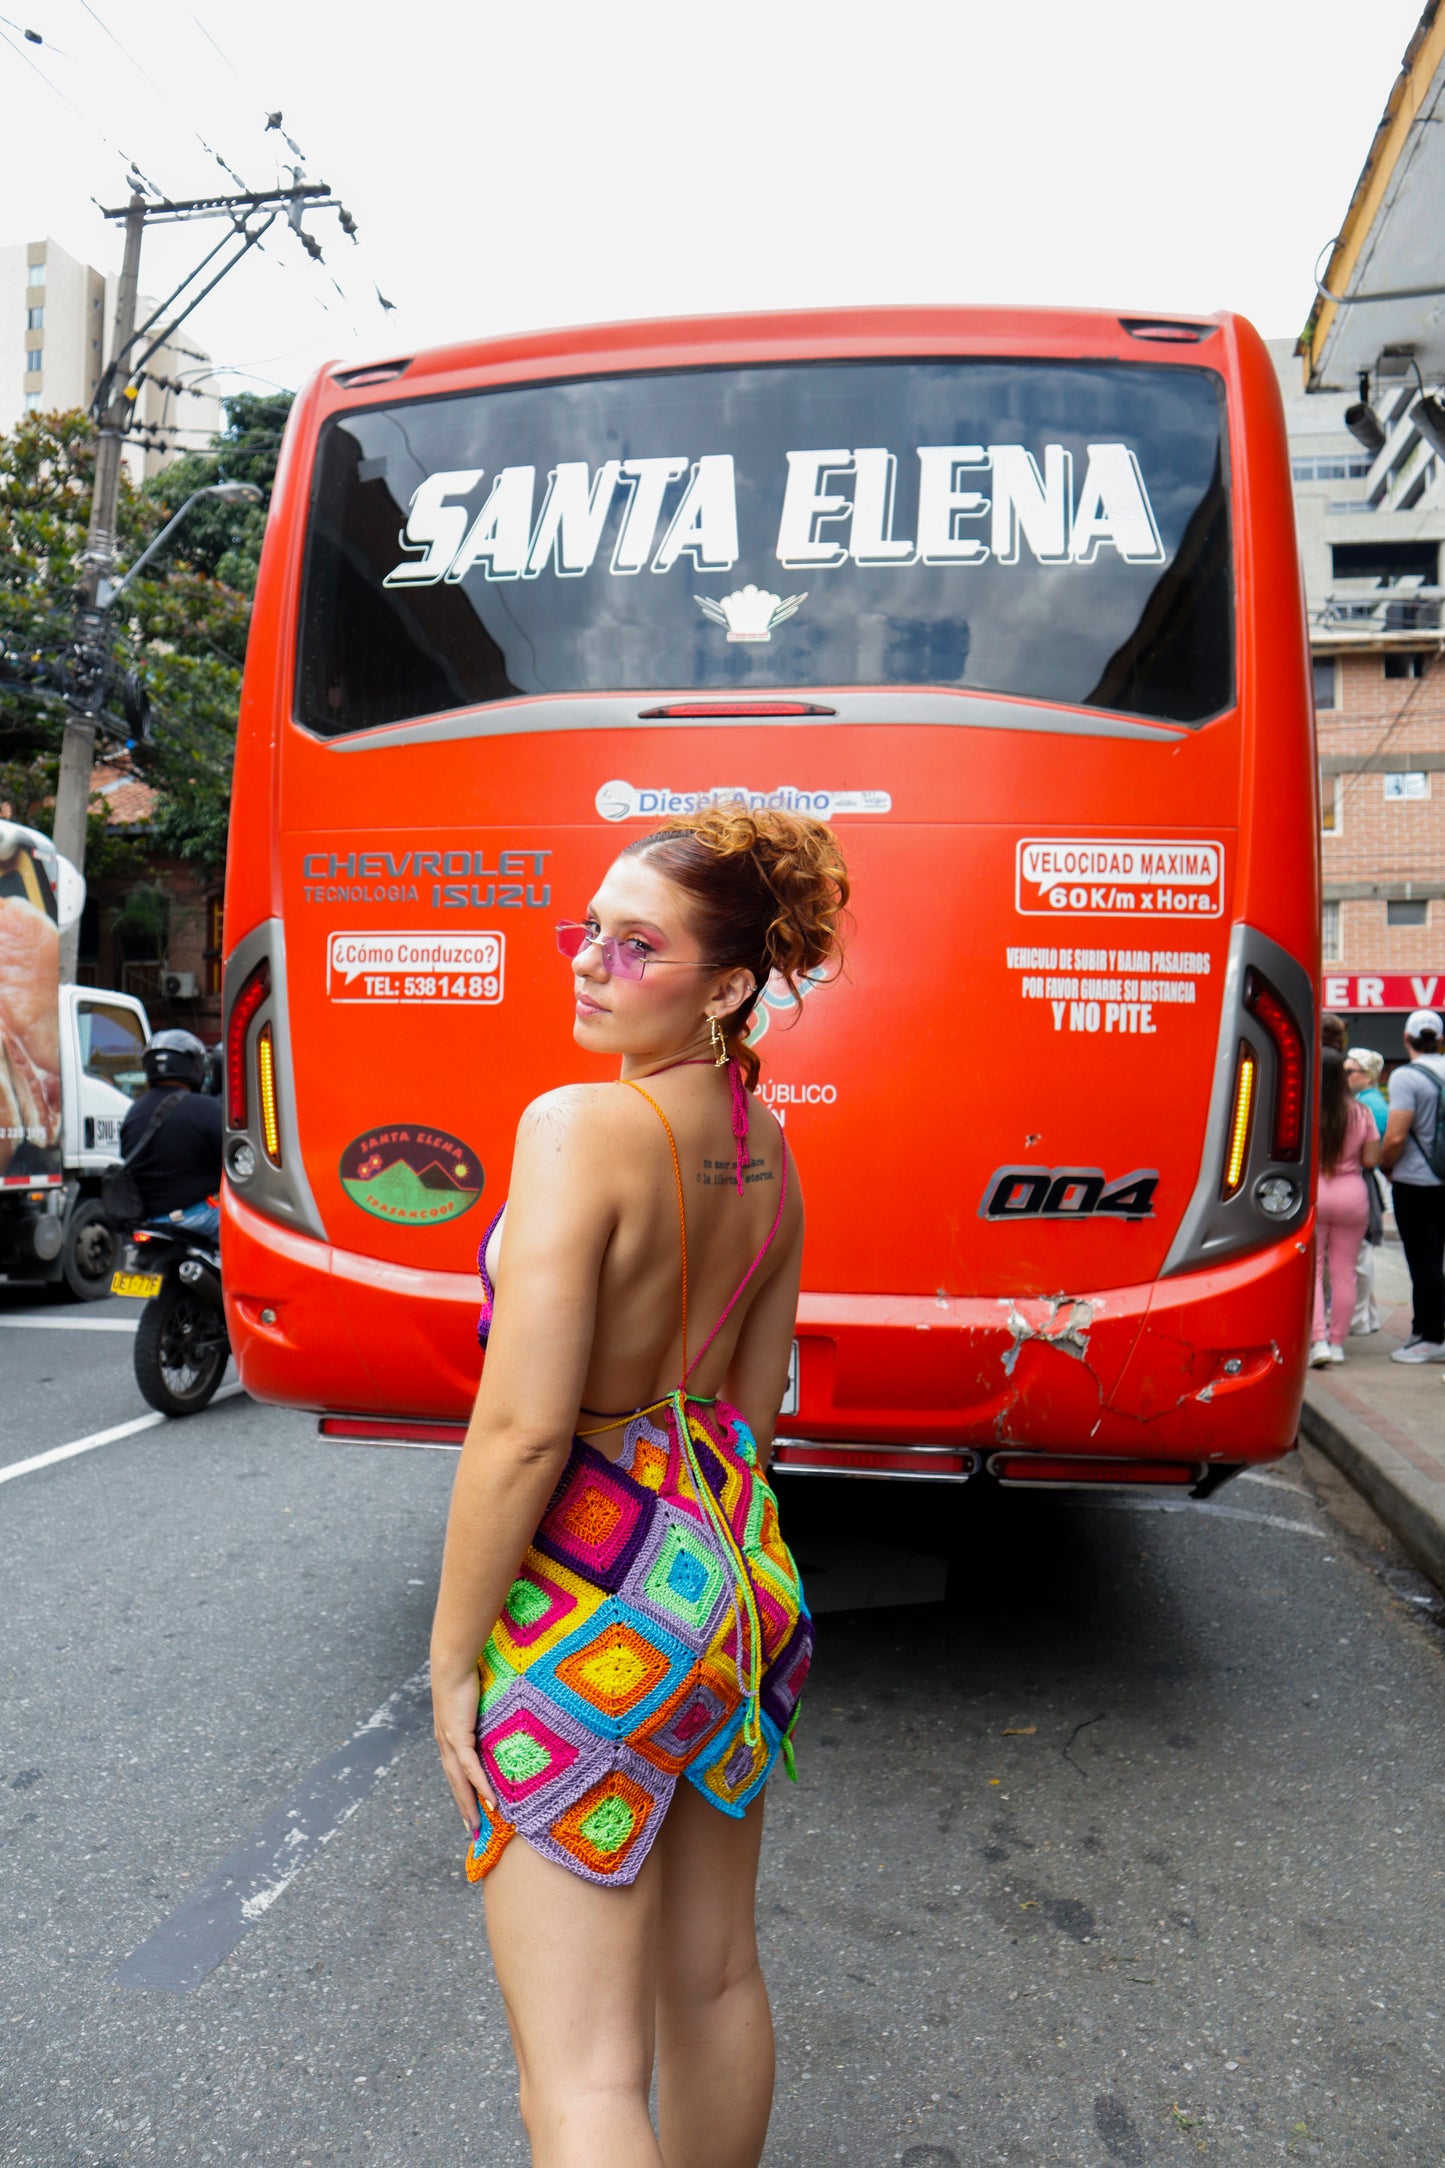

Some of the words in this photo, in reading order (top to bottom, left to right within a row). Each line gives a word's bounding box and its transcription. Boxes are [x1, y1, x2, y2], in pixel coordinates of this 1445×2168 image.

[383, 454, 739, 587] SANTA
[776, 443, 1165, 569] ELENA
[639, 792, 718, 812] Diesel
[731, 791, 830, 811] Andino
[303, 850, 552, 878] CHEVROLET
[1030, 852, 1134, 875] VELOCIDAD
[1141, 853, 1211, 876] MAXIMA
[303, 885, 419, 904] TECNOLOGIA
[431, 884, 552, 909] ISUZU
[336, 943, 394, 964] ¿Cómo
[398, 944, 495, 964] Conduzco?
[1006, 946, 1058, 971] VEHICULO
[1059, 948, 1073, 971] DE
[1074, 948, 1108, 972] SUBIR
[1109, 950, 1118, 972] Y
[1117, 950, 1151, 973] BAJAR
[1152, 951, 1211, 975] PASAJEROS
[364, 976, 400, 996] TEL:
[404, 975, 498, 998] 5381489
[1022, 976, 1044, 999] POR
[1046, 977, 1079, 1000] FAVOR
[1081, 977, 1123, 1002] GUARDE
[1124, 979, 1138, 1002] SU
[1140, 979, 1196, 1004] DISTANCIA
[1410, 977, 1445, 1007] V
[1051, 1000, 1067, 1032] Y
[1069, 1001, 1101, 1033] NO
[1105, 1002, 1157, 1034] PITE.
[360, 1131, 410, 1153] SANTA
[416, 1132, 464, 1160] ELENA
[365, 1194, 456, 1219] TRASANCOOP
[977, 1164, 1160, 1221] 004
